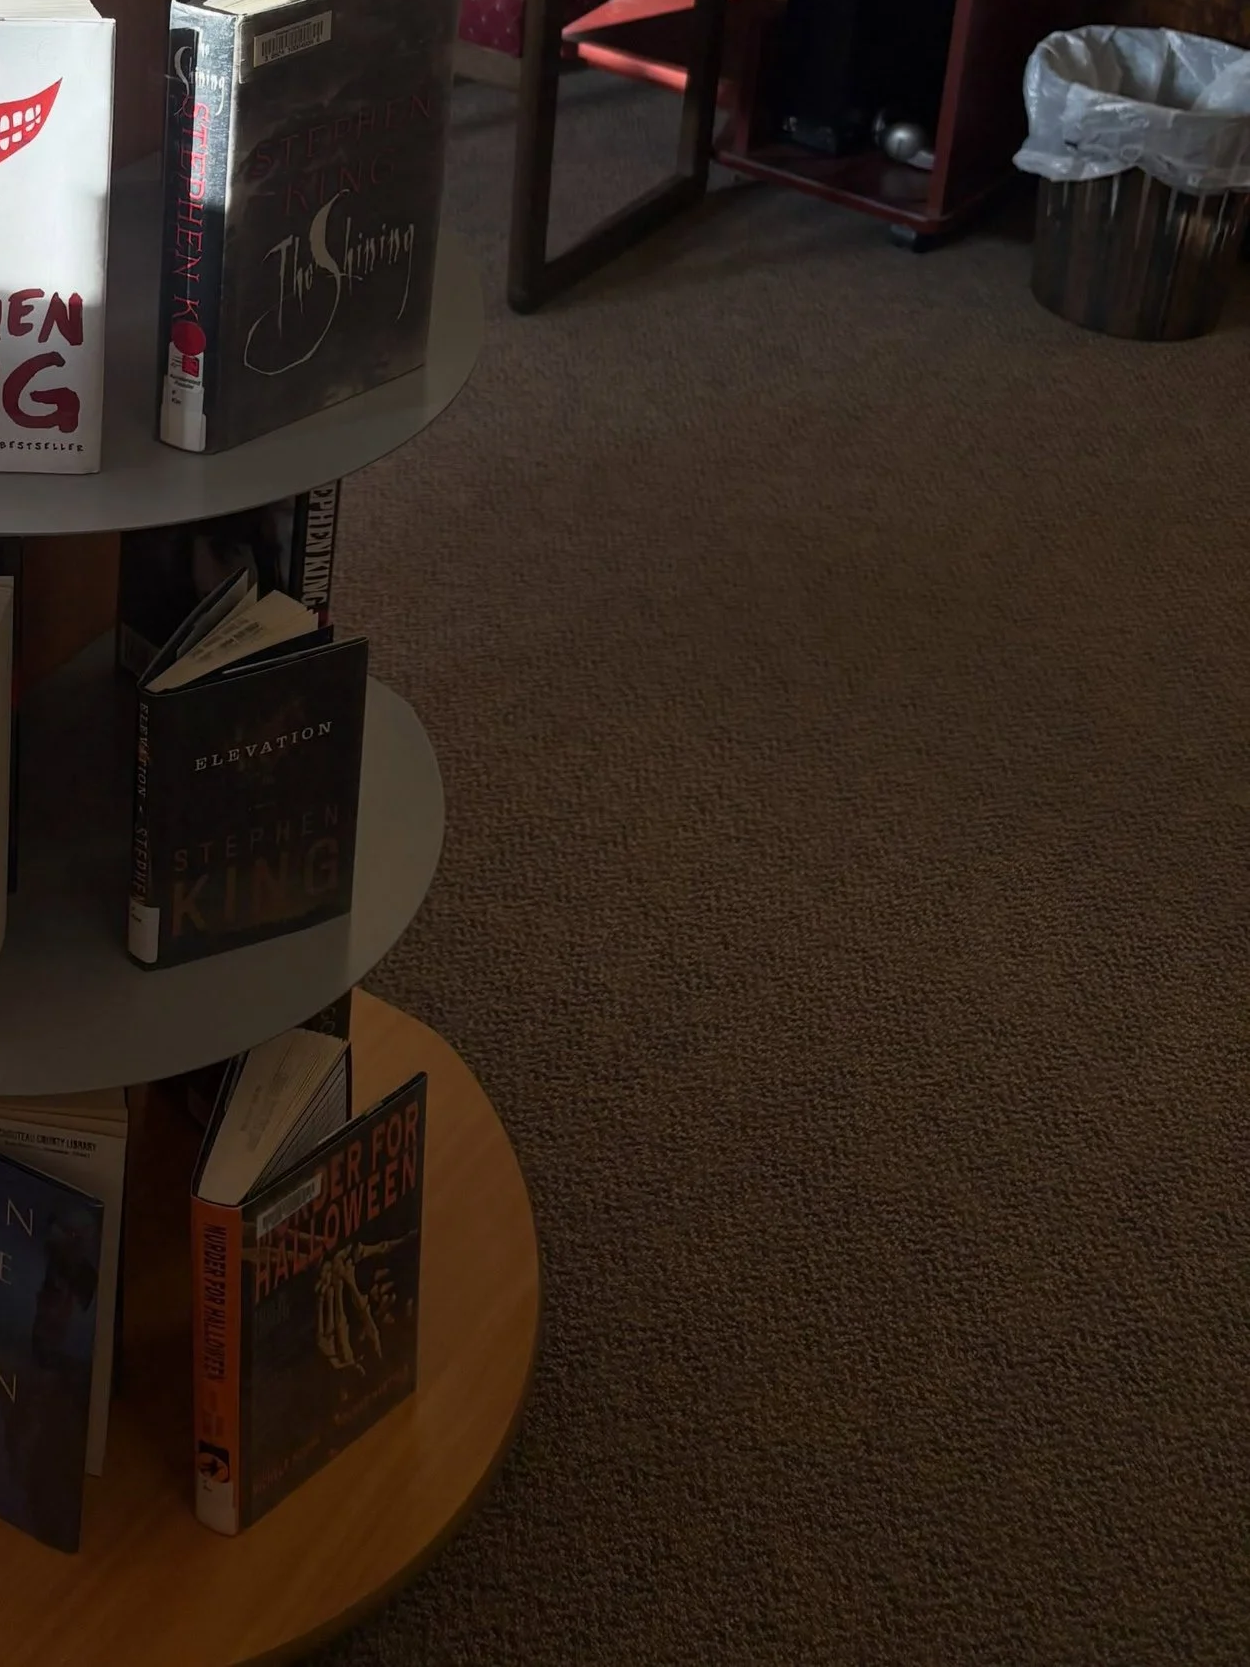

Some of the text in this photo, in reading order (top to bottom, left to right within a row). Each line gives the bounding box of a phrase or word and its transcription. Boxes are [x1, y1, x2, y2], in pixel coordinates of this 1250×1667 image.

[250, 93, 431, 178] STEPHEN
[173, 94, 210, 283] STEPHEN
[284, 147, 396, 217] KING
[262, 234, 314, 337] The
[0, 440, 85, 453] BESTSELLER
[192, 720, 334, 774] ELEVATION
[173, 804, 339, 873] STEPHEN
[170, 836, 339, 938] KING
[371, 1100, 419, 1172] FOR
[255, 1144, 419, 1306] HALLOWEEN
